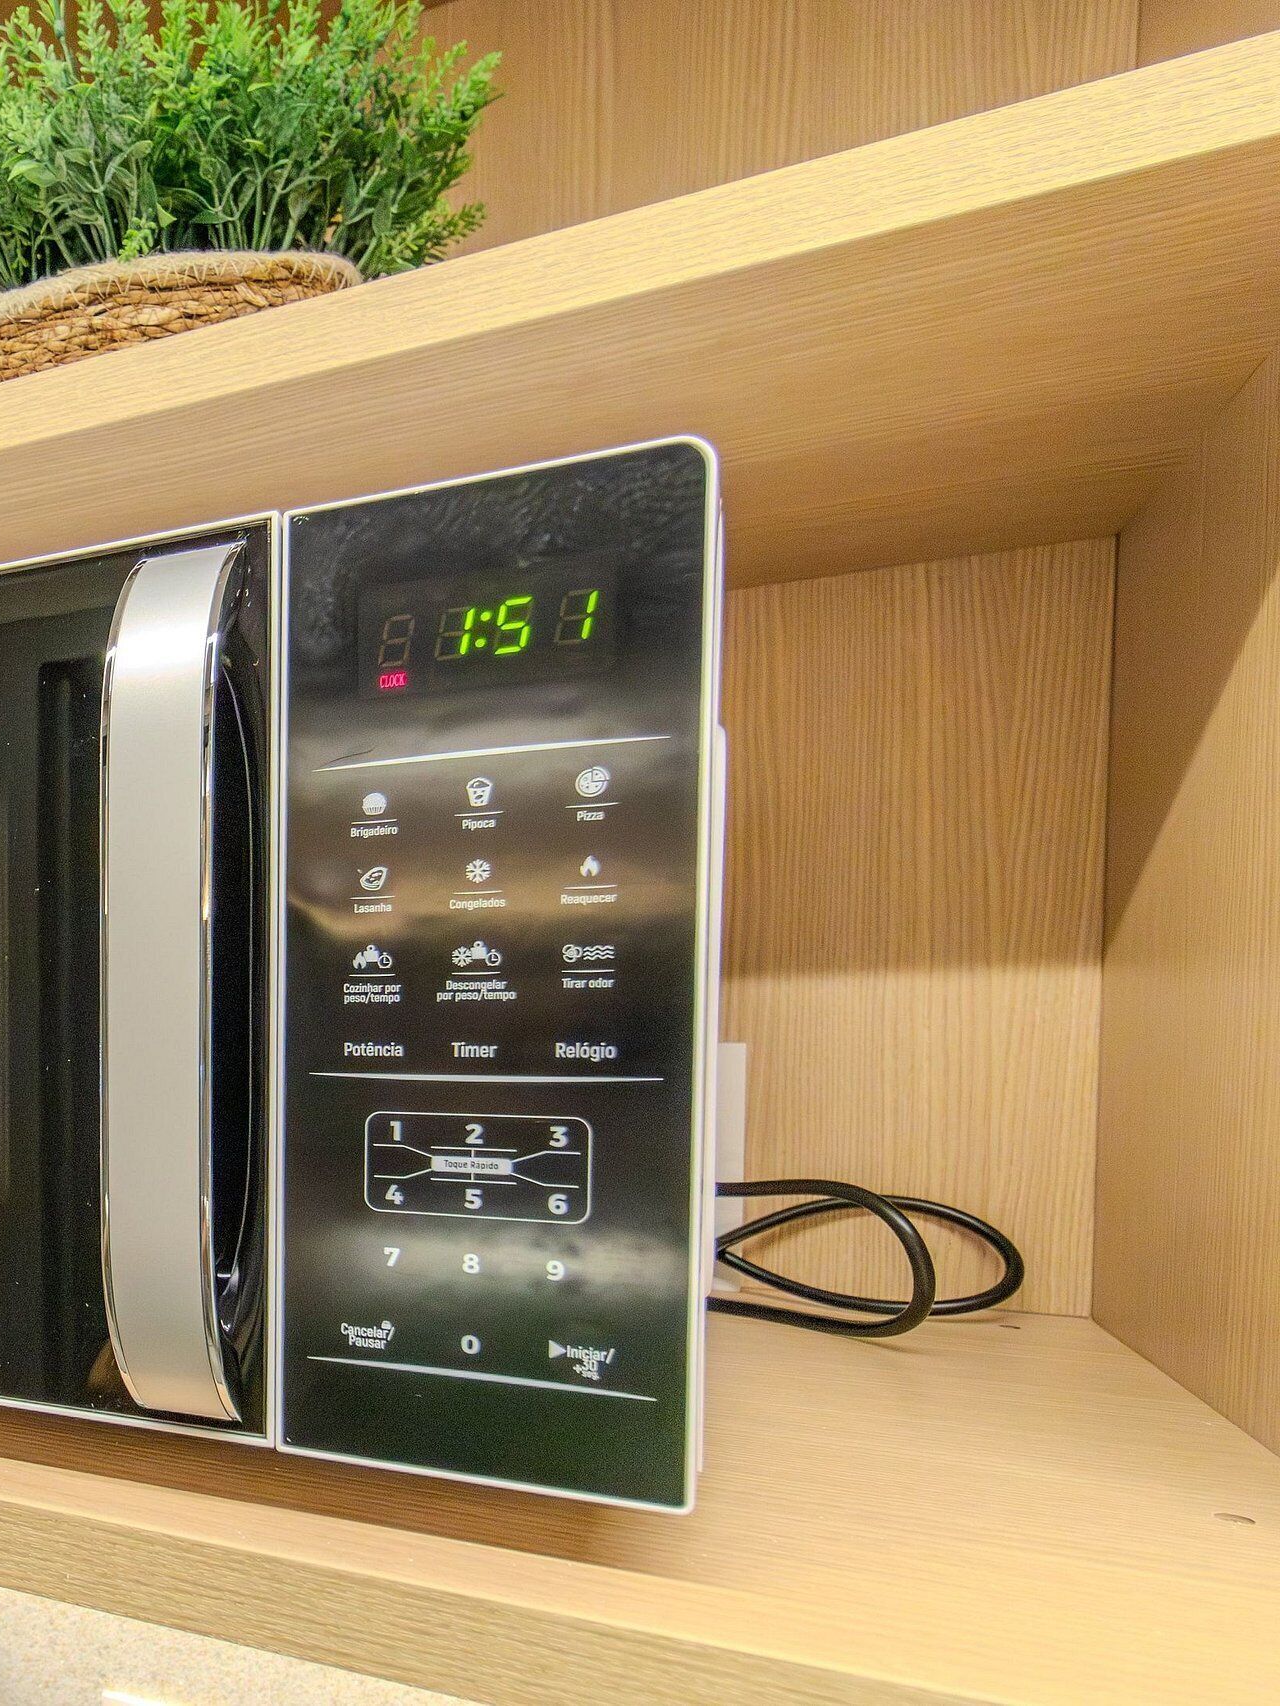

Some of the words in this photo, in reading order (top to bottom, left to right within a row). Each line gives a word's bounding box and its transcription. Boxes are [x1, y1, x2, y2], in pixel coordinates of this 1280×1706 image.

[379, 673, 407, 688] CLOCK
[576, 811, 605, 821] Pizza
[350, 825, 398, 838] Brigadeiro
[462, 819, 496, 830] Pipoca
[449, 898, 506, 910] Congelados
[560, 893, 618, 905] Reaquecer
[354, 903, 392, 913] Lasanha
[343, 983, 383, 993] Cozinhar
[385, 984, 401, 995] por
[446, 979, 507, 993] Descongelar
[562, 978, 585, 988] Tirar
[588, 978, 614, 988] odor
[343, 992, 401, 1004] peso/tempo
[437, 991, 453, 1001] por
[455, 989, 516, 1001] peso/tempo
[344, 1042, 403, 1057] Potência
[451, 1042, 497, 1058] Timer
[555, 1042, 616, 1062] Relógio
[390, 1121, 402, 1141] 1
[465, 1124, 484, 1144] 2
[549, 1126, 568, 1148] 3
[444, 1160, 468, 1169] Toque
[385, 1184, 404, 1205] 4
[464, 1189, 483, 1210] 5
[548, 1193, 569, 1215] 6
[384, 1247, 400, 1267] 7
[462, 1253, 480, 1274] 8
[546, 1260, 565, 1281] 9
[341, 1322, 395, 1341] Cancelar/
[348, 1334, 387, 1350] Pausar
[460, 1334, 481, 1355] 0
[566, 1345, 616, 1364] Iniciar/
